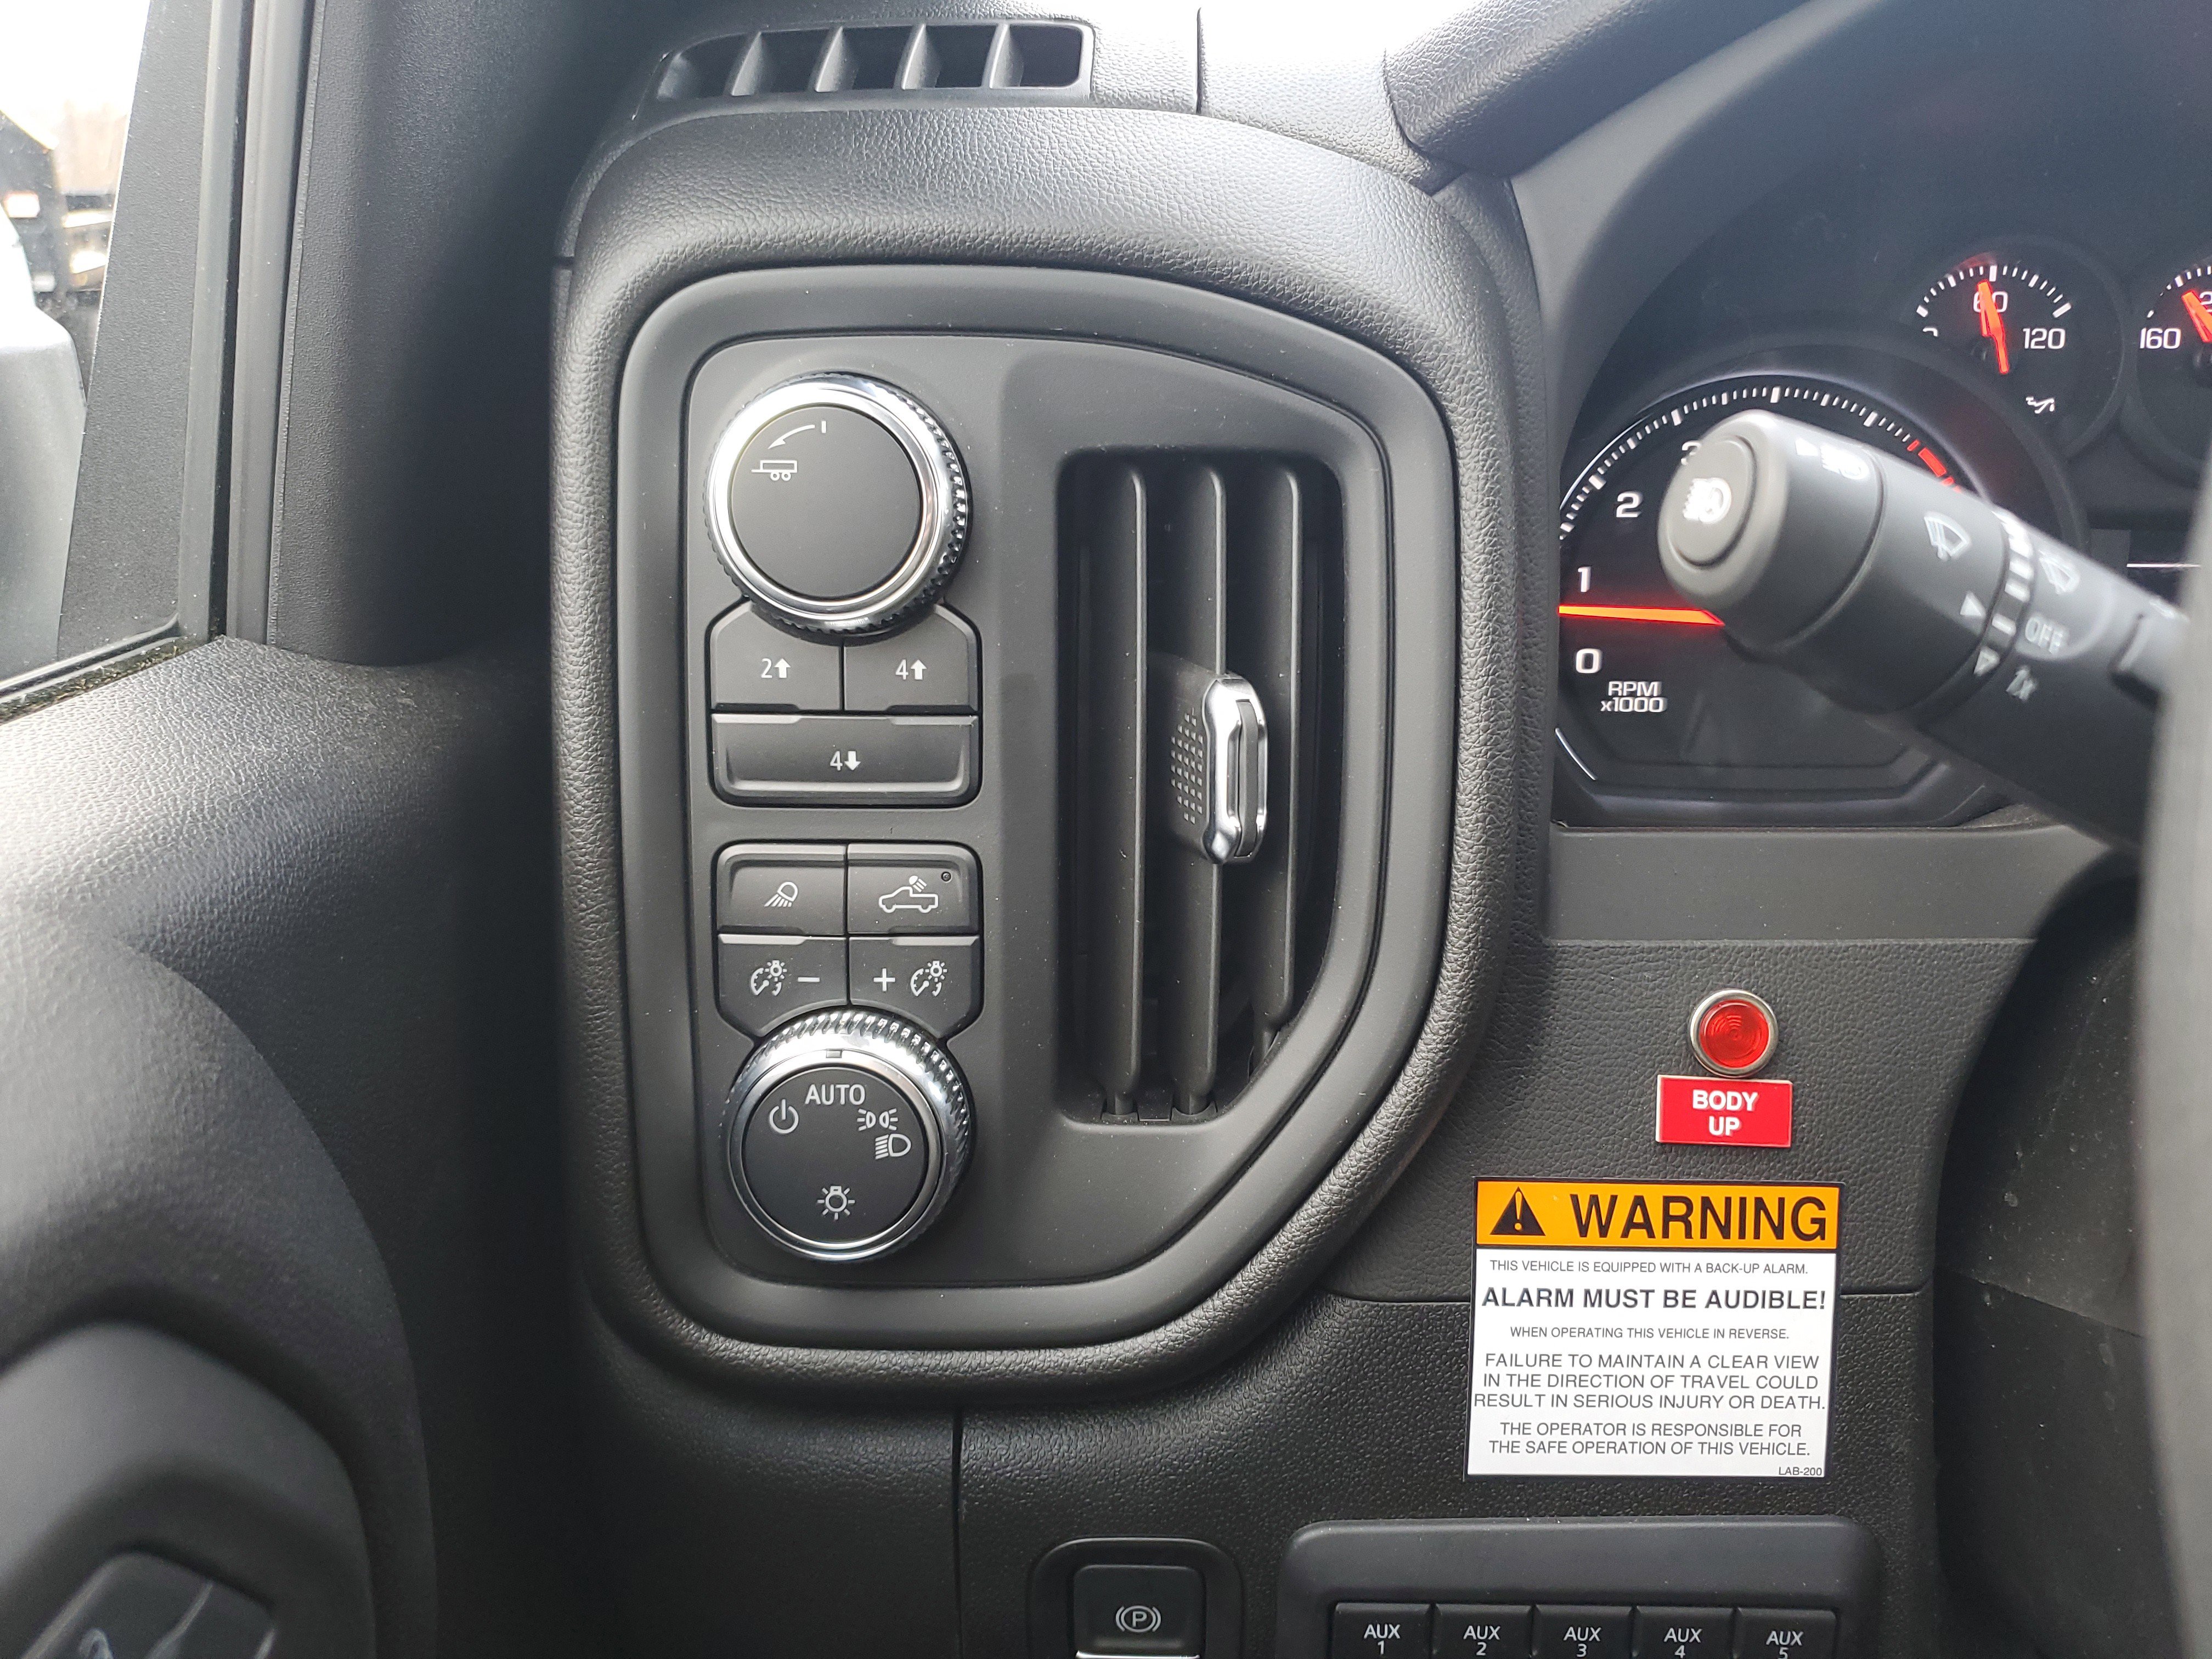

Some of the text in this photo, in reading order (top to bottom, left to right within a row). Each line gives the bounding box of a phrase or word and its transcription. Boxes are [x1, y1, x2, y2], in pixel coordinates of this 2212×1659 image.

[2023, 328, 2066, 349] 120
[2140, 327, 2181, 349] 160
[1616, 492, 1643, 518] 2
[1578, 566, 1591, 592] 1
[2025, 614, 2066, 654] OFF
[1575, 648, 1602, 674] 0
[1608, 681, 1661, 697] RPM
[1600, 697, 1667, 713] x1000
[805, 1084, 866, 1105] AUTO
[1692, 1090, 1758, 1111] BODY
[1708, 1116, 1741, 1136] UP
[1570, 1194, 1826, 1240] WARNING
[1489, 1260, 1808, 1274] THIS VEHICLE IS EQUIPPED WITH A BACK-UP ALARM.
[1481, 1286, 1826, 1310] ALARM MUST BE AUDIBLE!
[1510, 1327, 1789, 1339] WHEN OPERATING THIS VEHICLE IN REVERSE.
[1486, 1353, 1819, 1369] FAILURE TO MAINTAIN A CLEAR VIEW
[1483, 1373, 1818, 1389] IN THE DIRECTION OF TRAVEL COULD
[1474, 1393, 1825, 1409] RESULT IN SERIOUS INJURY OR DEATH.
[1500, 1422, 1802, 1437] THE OPERATOR IS RESPONSIBLE FOR
[1488, 1440, 1810, 1456] THE SAFE OPERATION OF THIS VEHICLE.
[1779, 1466, 1822, 1476] LAB-200
[1364, 1624, 1401, 1639] AUX
[1464, 1625, 1500, 1640] AUX
[1564, 1627, 1601, 1642] AUX
[1664, 1628, 1702, 1643] AUX
[1766, 1631, 1803, 1646] AUX
[1377, 1641, 1384, 1655] 1
[1476, 1642, 1486, 1656] 2
[1577, 1643, 1587, 1657] 3
[1674, 1645, 1686, 1658] 4
[1779, 1647, 1788, 1659] 5
